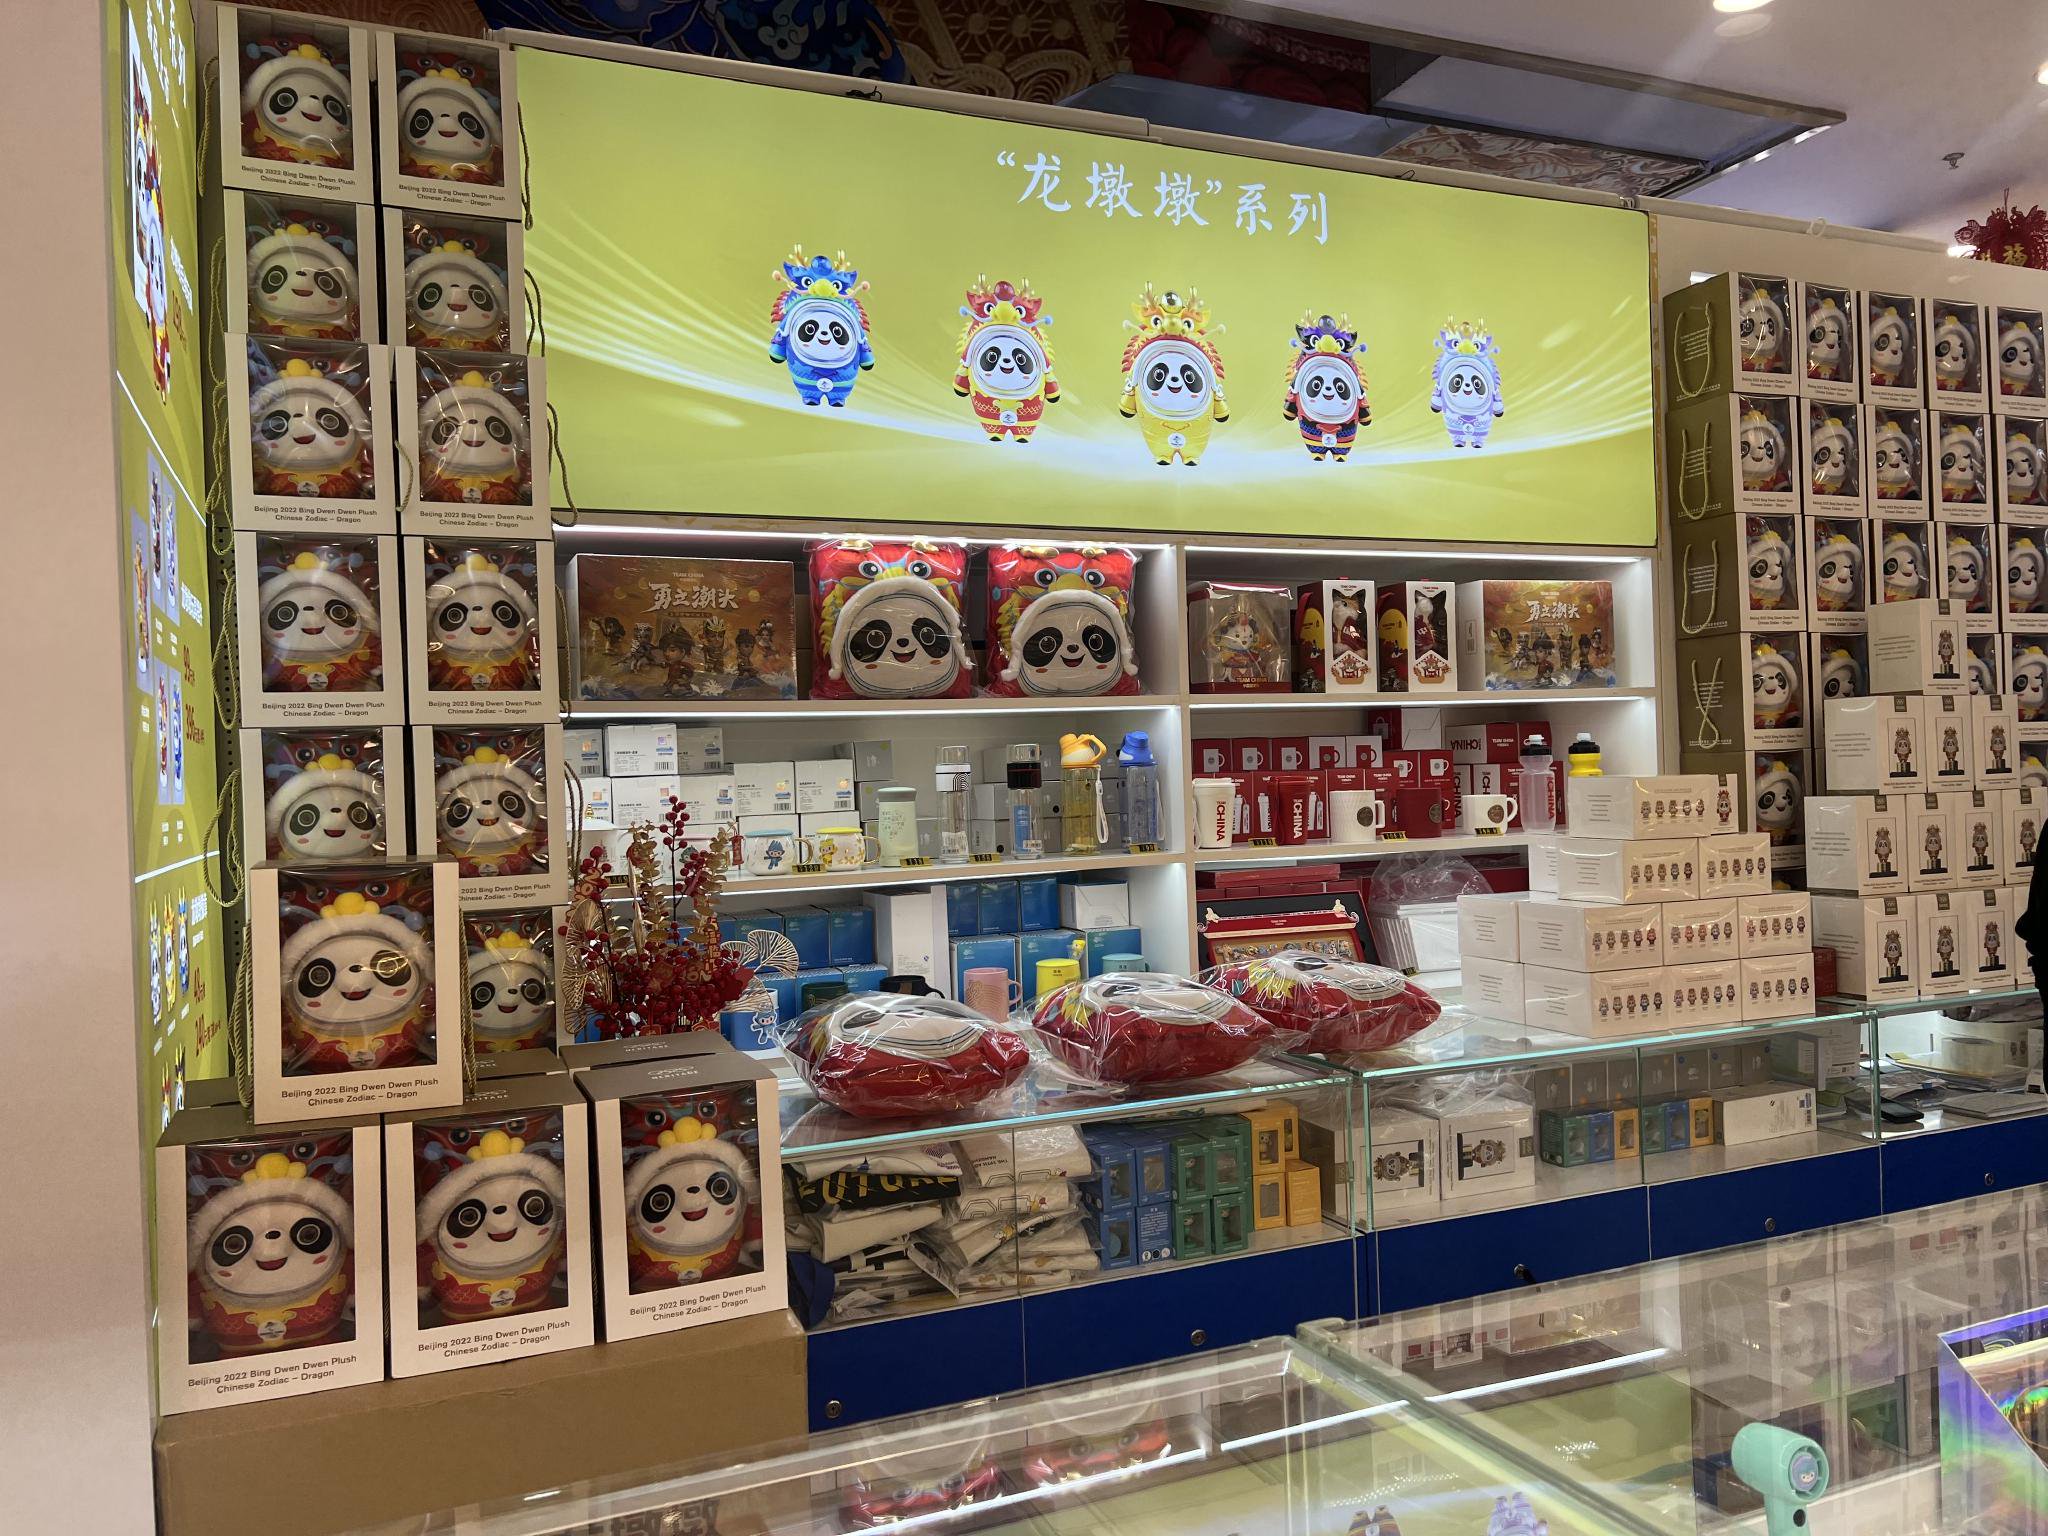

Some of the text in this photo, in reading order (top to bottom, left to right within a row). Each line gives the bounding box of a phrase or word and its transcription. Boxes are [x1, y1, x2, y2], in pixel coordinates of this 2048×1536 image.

[241, 165, 263, 174] Beijing
[283, 170, 297, 179] Bing
[299, 172, 317, 180] Dwen
[318, 175, 336, 183] Dwen
[260, 175, 287, 184] Chinese
[288, 179, 310, 187] Zodiac
[317, 183, 341, 191] Dragon
[399, 184, 420, 193] Beijing
[438, 188, 451, 196] Bing
[417, 193, 442, 201] Chinese
[470, 199, 491, 207] Dragon
[254, 505, 278, 513] Beijing
[1547, 781, 1555, 820] CHINA
[1216, 804, 1226, 842] CHINA
[1293, 802, 1303, 839] CHINA
[479, 886, 493, 894] Bing
[513, 891, 536, 899] Dragon
[651, 1070, 699, 1080] HERITAGE
[281, 1078, 439, 1099] Beijing 2022 Bing Dwen Dwen Plush
[308, 1096, 344, 1107] Chinese
[347, 1094, 376, 1103] Zodiac
[386, 1090, 418, 1099] Dragon
[630, 1285, 767, 1316] Beijing 2022 Bing Dwen Dwen Plush
[653, 1310, 684, 1321] Chinese
[686, 1305, 712, 1315] Zodiac
[721, 1298, 749, 1309] Dragon
[418, 1320, 571, 1352] Beijing 2022 Bing Dwen Dwen Plush
[444, 1346, 479, 1358] Chinese
[481, 1341, 510, 1351] Zodiac
[520, 1335, 550, 1346] Dragon
[188, 1355, 357, 1388] Beijing 2022 Bing Dwen Dwen Plush
[216, 1382, 255, 1394] Chinese
[258, 1377, 290, 1387] Zodiac
[301, 1369, 335, 1382] Dragon
